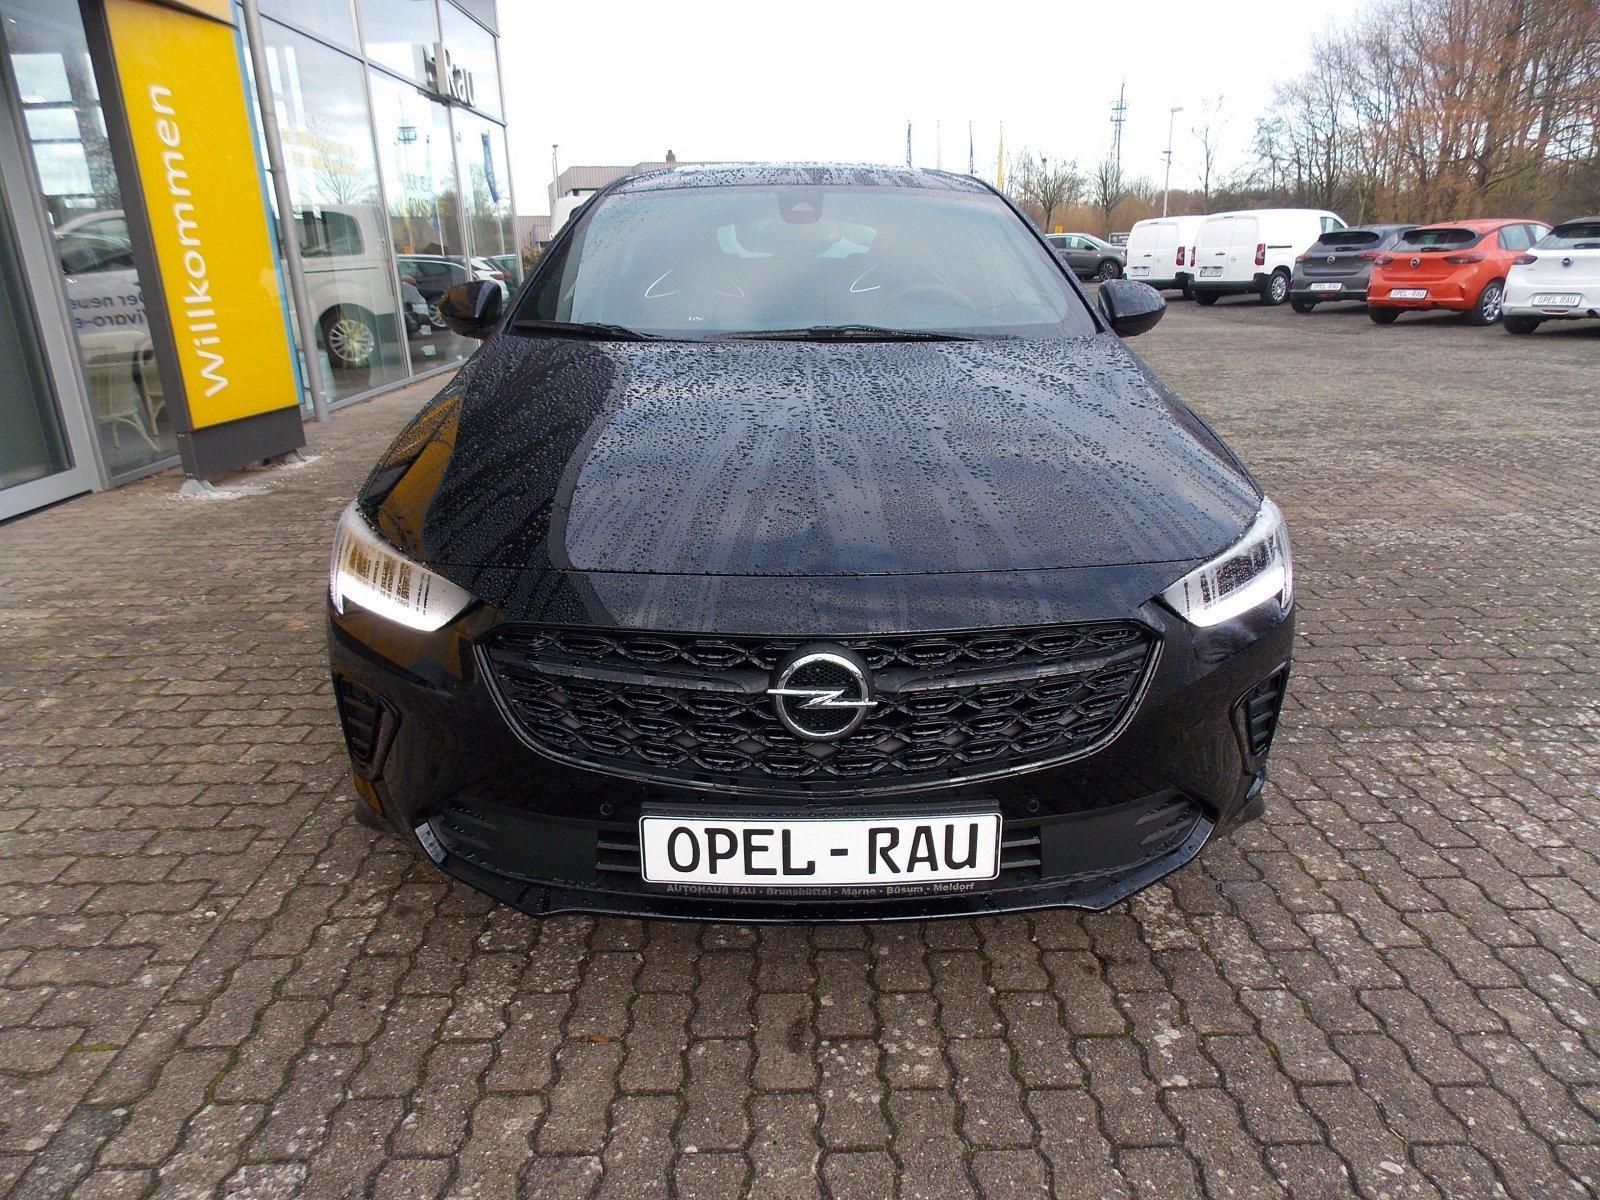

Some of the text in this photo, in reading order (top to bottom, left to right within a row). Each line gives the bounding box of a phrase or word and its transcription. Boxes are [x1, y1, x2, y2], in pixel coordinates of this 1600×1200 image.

[434, 43, 476, 108] Rau
[149, 84, 229, 398] Willkommen
[1537, 296, 1577, 304] OPEL RAU
[667, 823, 979, 876] OPEL - RAU
[666, 884, 729, 895] AUTOHAUS
[732, 887, 756, 896] RAU
[886, 885, 923, 895] Büsum
[933, 881, 975, 893] Meldorf
